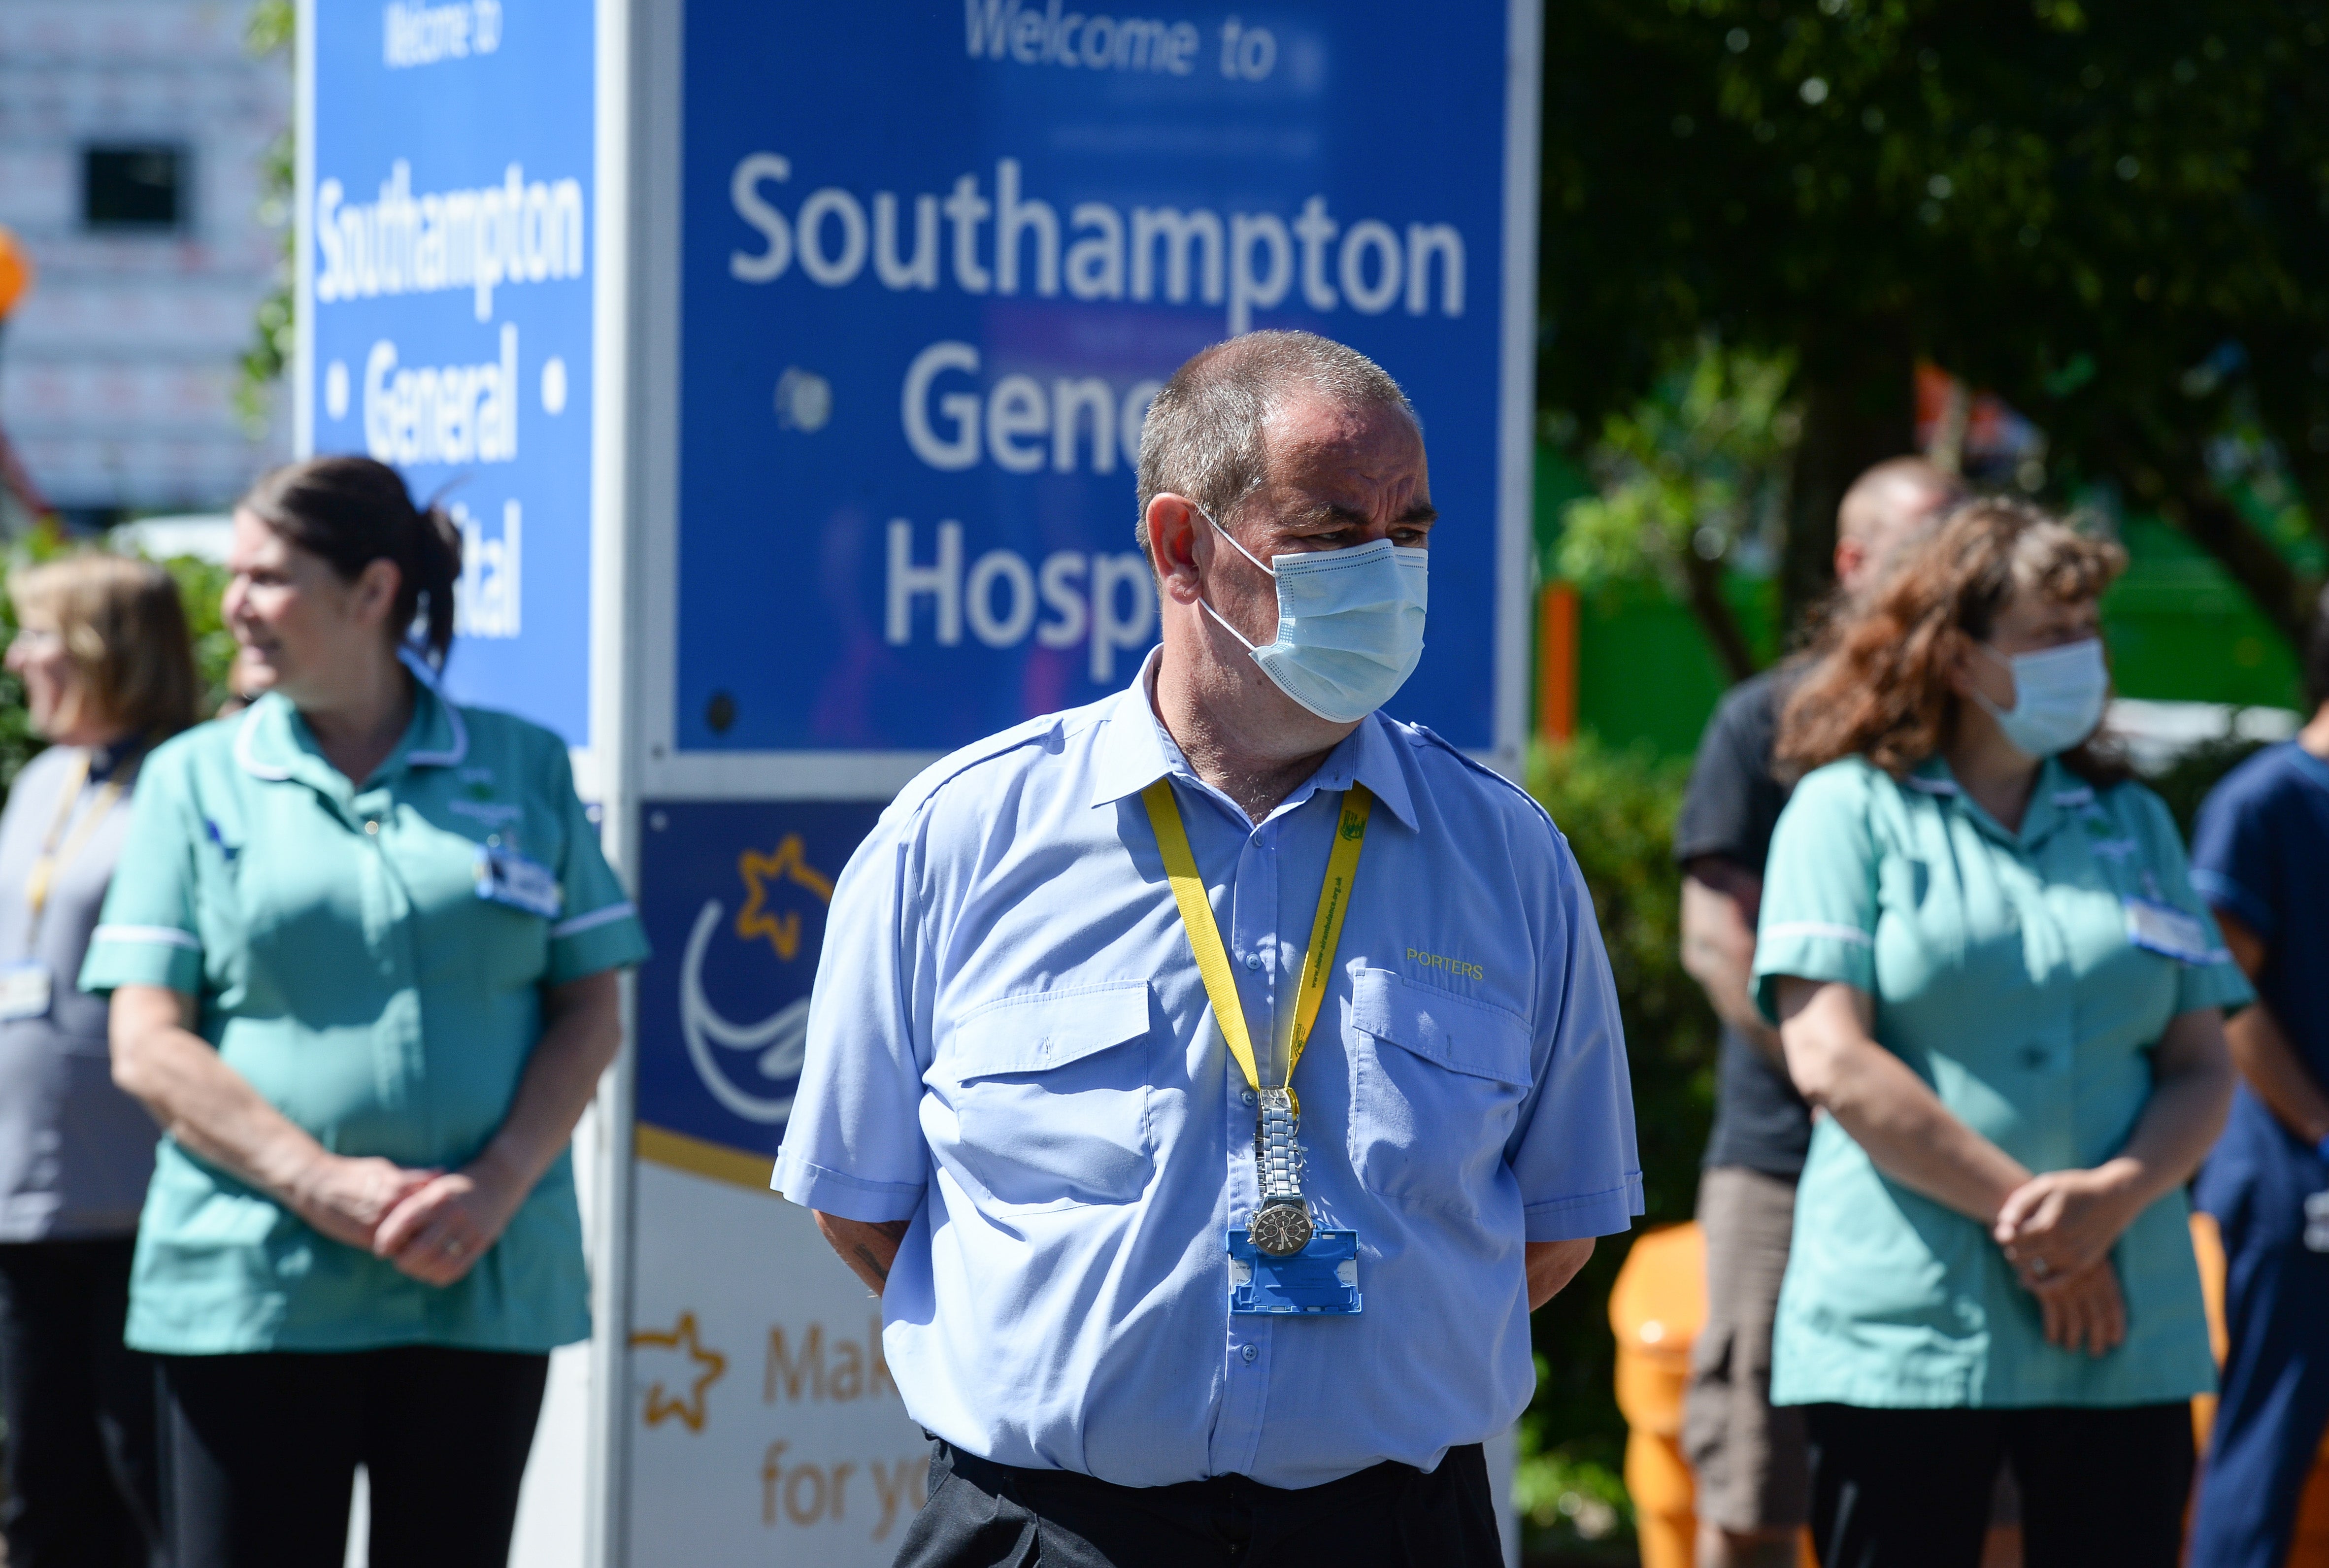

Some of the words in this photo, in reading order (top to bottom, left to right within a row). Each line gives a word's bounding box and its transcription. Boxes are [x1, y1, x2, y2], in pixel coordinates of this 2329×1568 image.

[965, 0, 1199, 76] Welcome
[1220, 14, 1277, 82] to
[316, 158, 584, 323] Southampton
[729, 151, 1466, 332] Southampton
[363, 322, 519, 465] General
[885, 518, 1158, 685] Hosp
[1406, 947, 1483, 981] PORTERS
[761, 1438, 856, 1528] for
